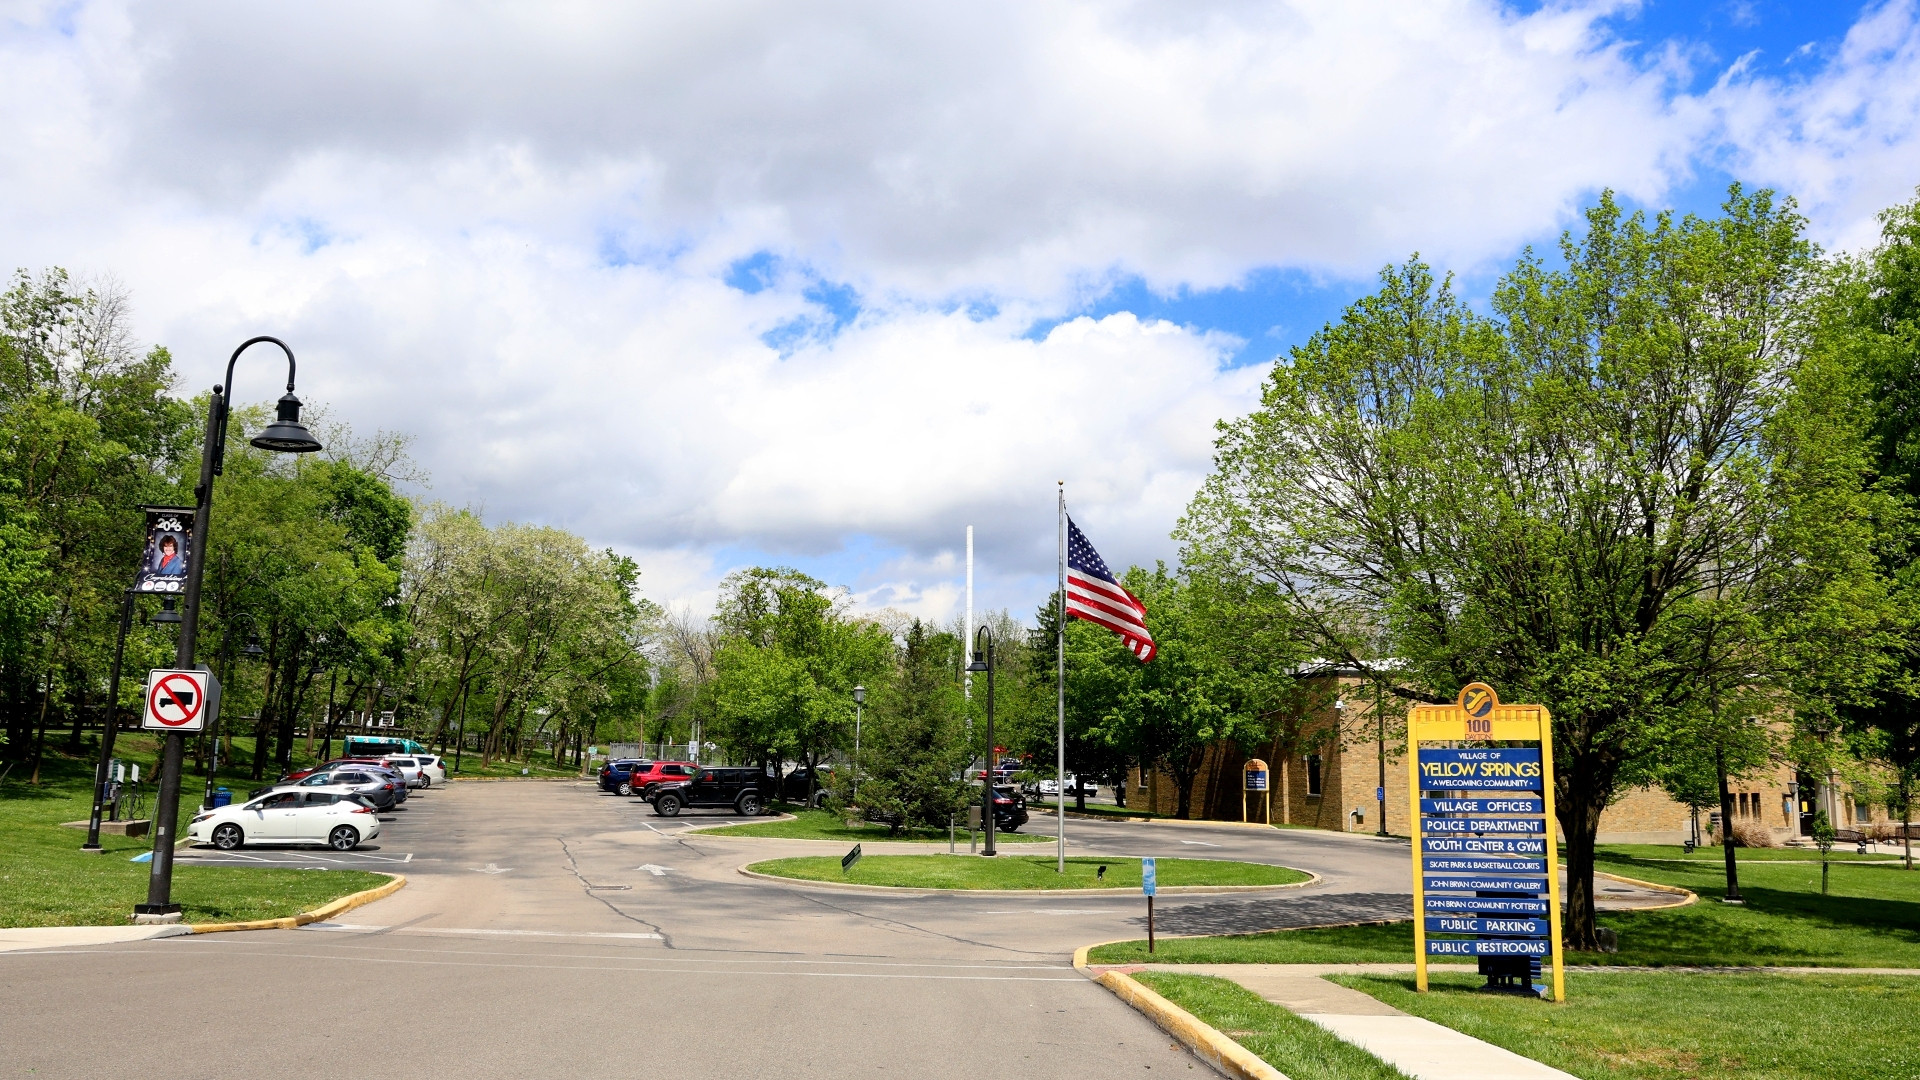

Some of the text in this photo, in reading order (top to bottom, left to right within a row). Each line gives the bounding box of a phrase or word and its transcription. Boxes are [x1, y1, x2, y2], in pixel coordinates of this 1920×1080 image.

[158, 518, 182, 531] 2026
[1467, 720, 1490, 732] 100
[1420, 762, 1540, 777] YELLOW SPRINGS
[1434, 802, 1532, 811] VILLAGE OFFICES
[1427, 821, 1539, 831] POLICE DEPARTMENT
[1427, 841, 1541, 851] YOUTH CENTER & GYM
[1474, 862, 1512, 870] BASKETBALL
[1441, 920, 1535, 932] PUBLIC PARKING
[1432, 943, 1545, 953] PUBLIC RESTROOMS
